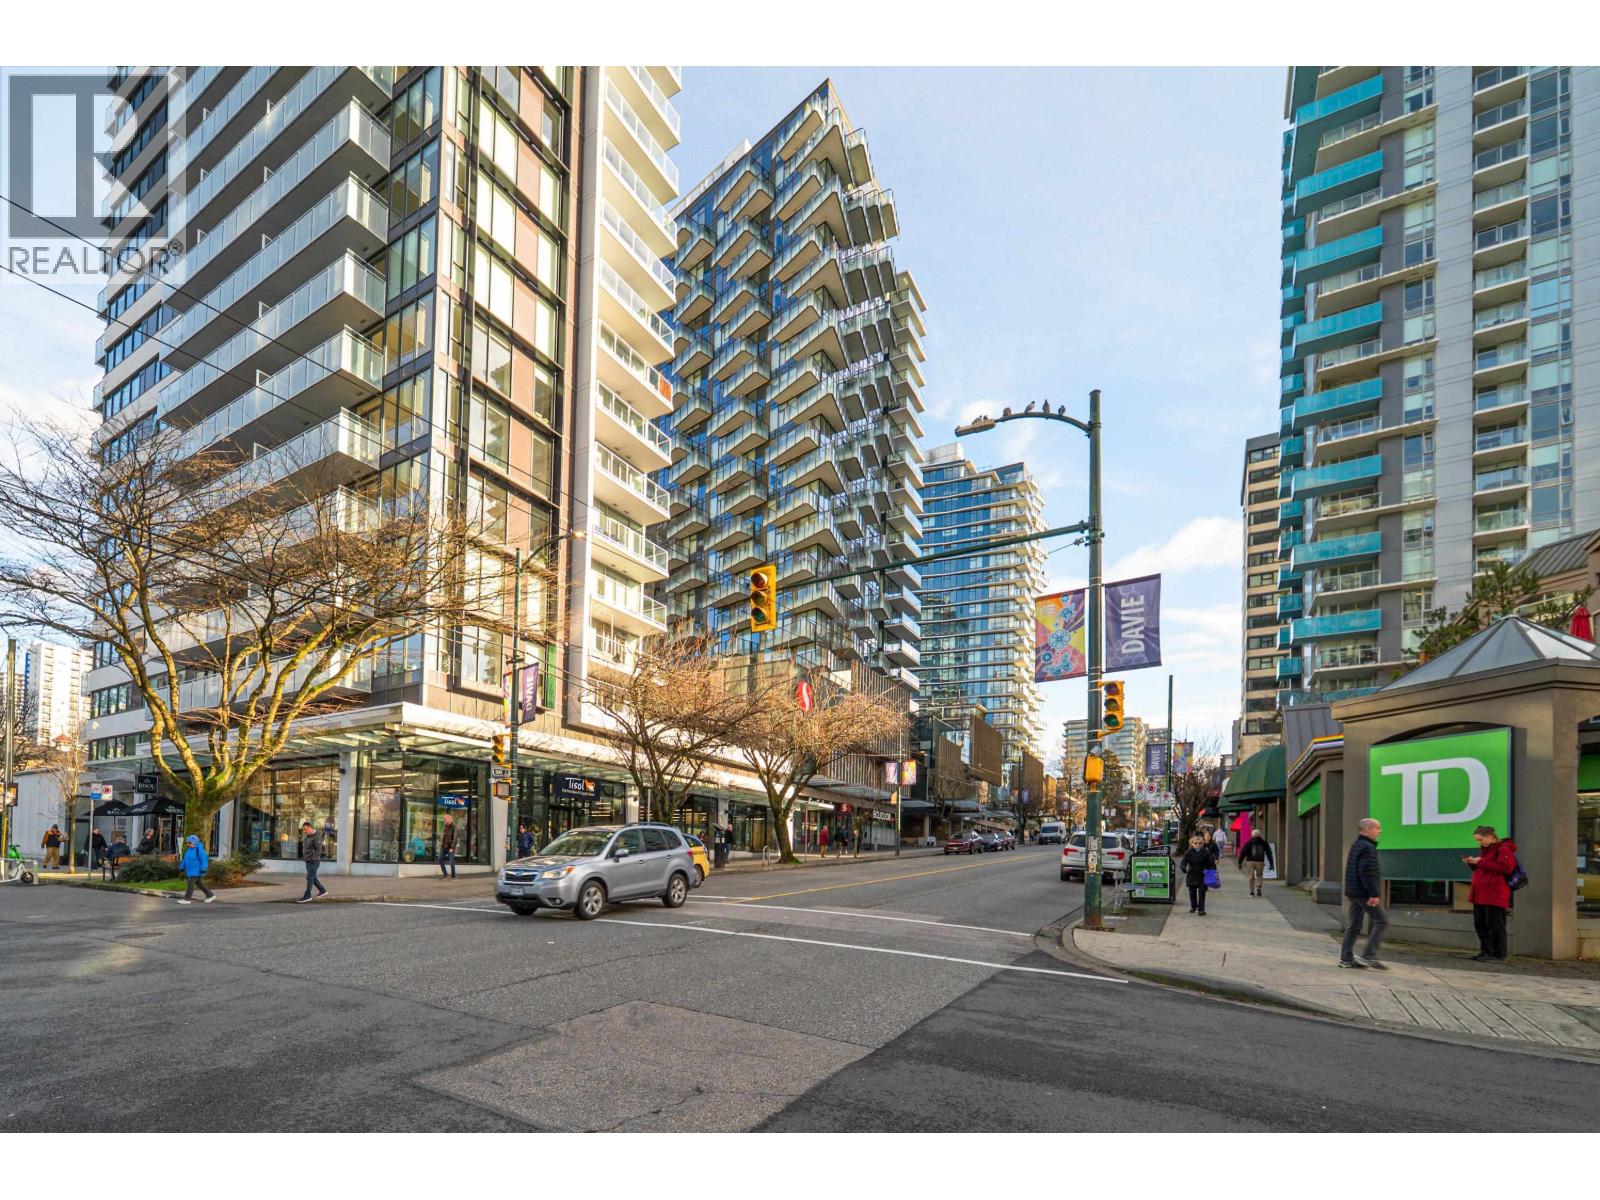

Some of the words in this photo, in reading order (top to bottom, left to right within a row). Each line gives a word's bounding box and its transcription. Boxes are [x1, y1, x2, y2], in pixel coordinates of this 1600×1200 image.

[1120, 594, 1145, 654] DAVIE
[526, 673, 534, 711] DAVIE
[1151, 749, 1160, 770] DAVIE
[565, 777, 585, 791] Tisol
[1381, 757, 1490, 826] TD
[442, 794, 457, 805] Tisol
